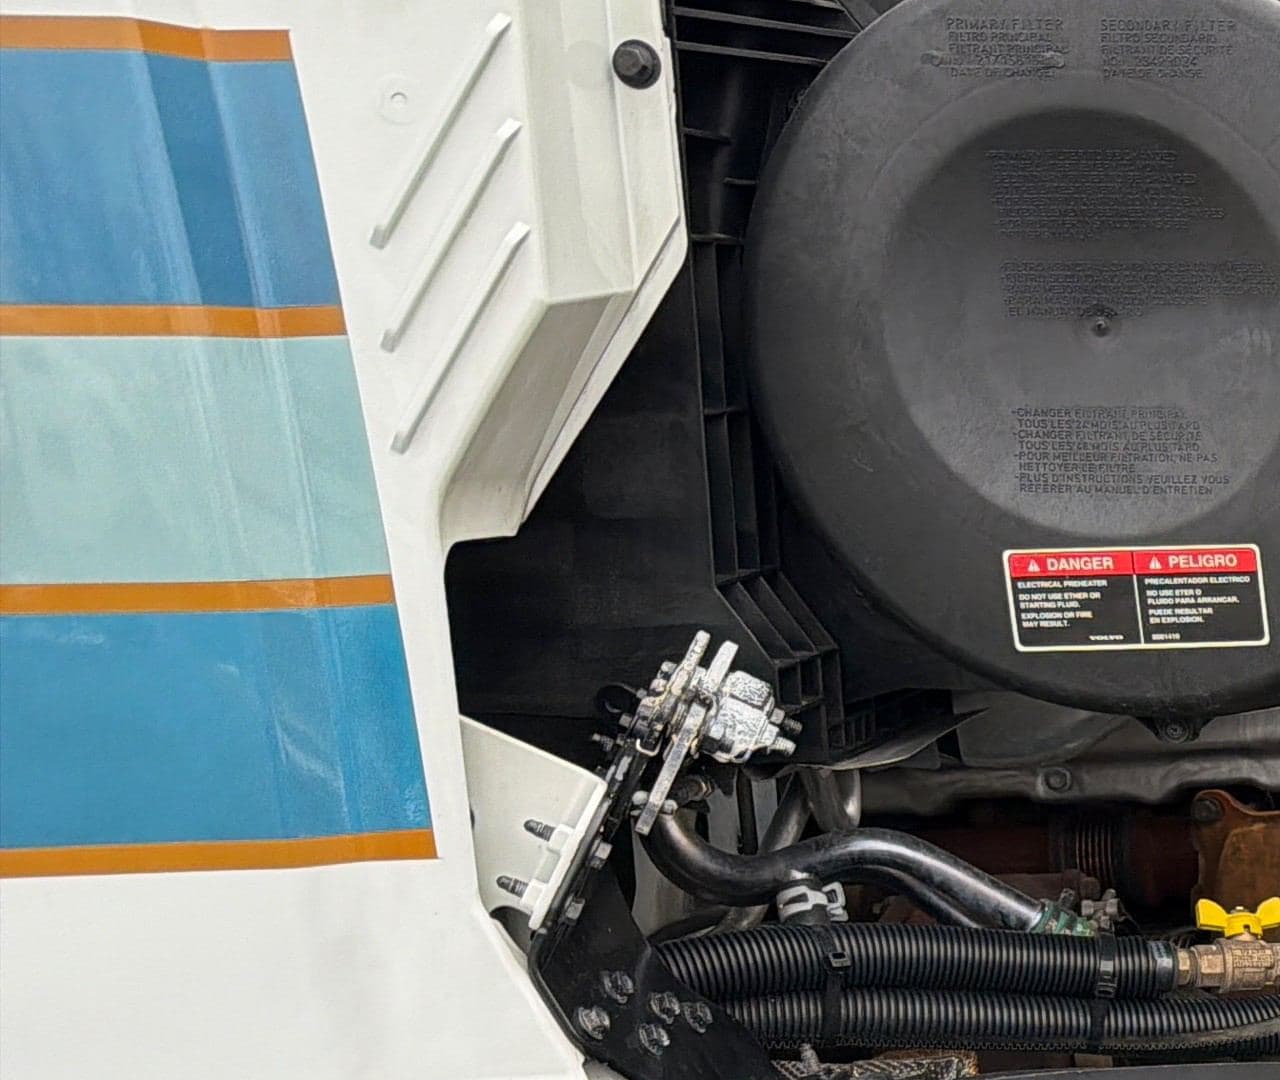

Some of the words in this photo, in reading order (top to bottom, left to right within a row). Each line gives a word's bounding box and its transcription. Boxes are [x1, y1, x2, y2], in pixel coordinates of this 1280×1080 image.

[947, 18, 1008, 30] PRIMARY
[1012, 18, 1064, 30] FILTER
[1100, 18, 1177, 31] SECONDARY
[1017, 418, 1047, 429] TOUS
[1050, 419, 1072, 429] LES
[1018, 440, 1048, 450] TOUS
[1051, 441, 1072, 451] LES
[1178, 453, 1193, 463] NE
[1196, 453, 1218, 463] PAS
[1019, 462, 1078, 472] NETTOYER
[1081, 463, 1097, 472] LE
[1099, 463, 1136, 473] FILTRE
[1146, 474, 1198, 485] VEUILLEZ
[1200, 474, 1231, 485] VOUS
[1075, 484, 1092, 494] AU
[1046, 556, 1114, 571] DANGER
[1168, 553, 1238, 569] PELIGRO
[1017, 580, 1062, 589] ELECTRICAL
[1063, 579, 1108, 588] PREHEATER
[1144, 577, 1208, 585] PRECALENTADOR
[1209, 576, 1251, 584] ELECTRICO
[1019, 593, 1030, 601] DO
[1031, 593, 1046, 601] NOT
[1047, 592, 1062, 600] USE
[1063, 592, 1088, 600] ETHER
[1146, 589, 1158, 597] NO
[1158, 589, 1174, 597] USE
[1019, 601, 1056, 609] STARTING
[1175, 597, 1195, 605] PARA
[1021, 611, 1062, 620] EXPLOSION
[1063, 611, 1074, 619] OR
[1148, 608, 1173, 616] PUEDE
[1174, 607, 1213, 615] RESULTAR
[1022, 620, 1038, 628] MAY
[1039, 620, 1071, 628] RESULT.
[1149, 617, 1160, 625] EN
